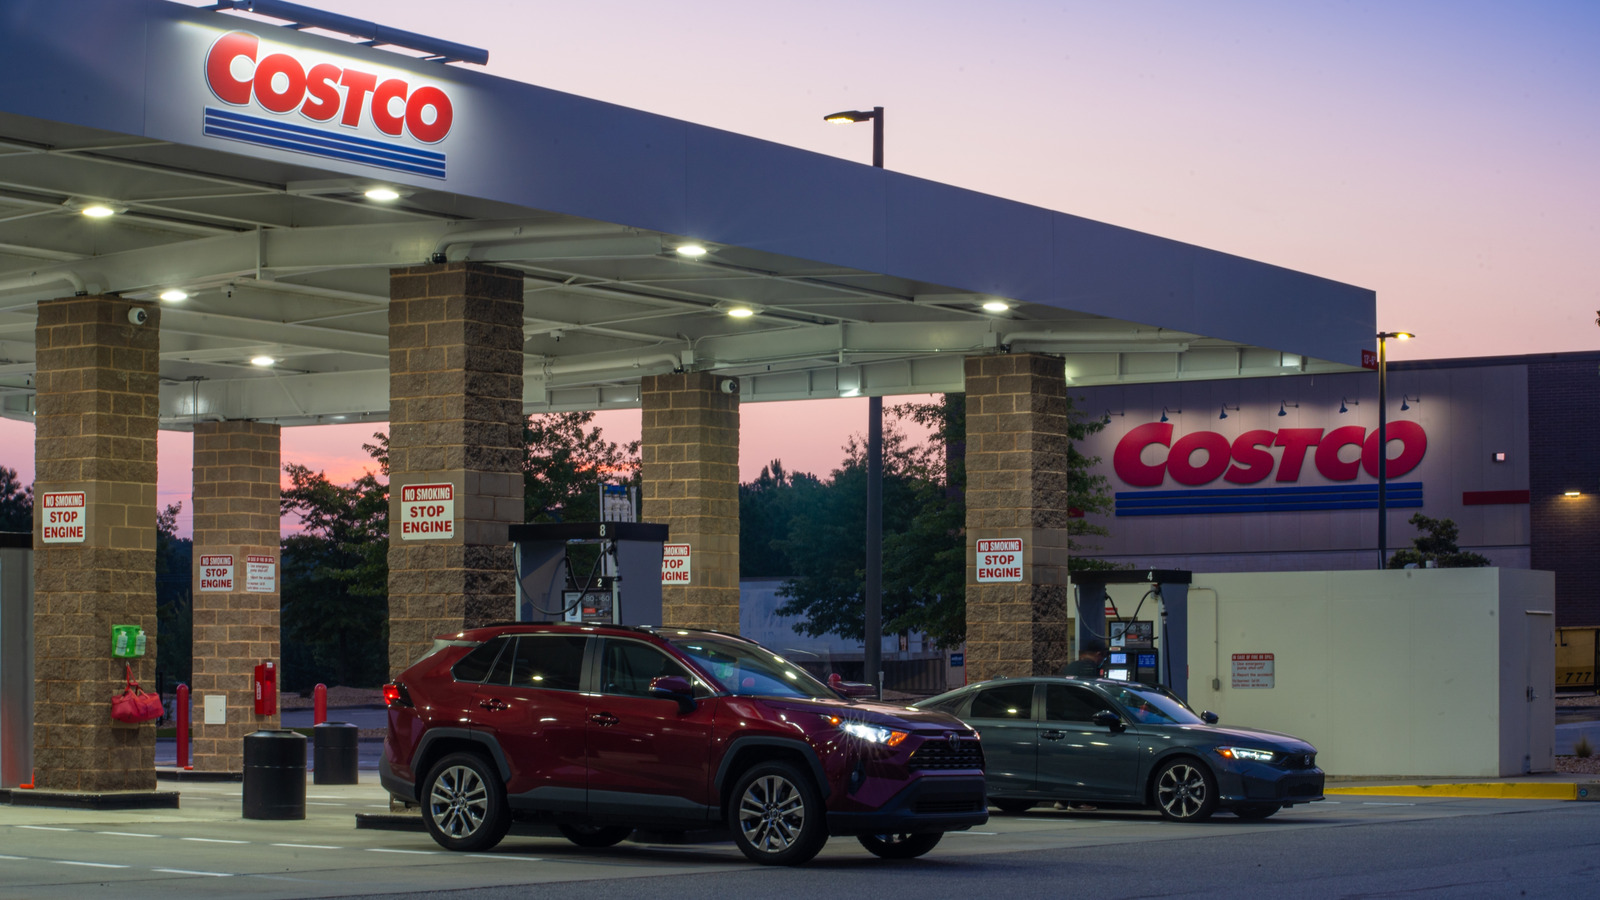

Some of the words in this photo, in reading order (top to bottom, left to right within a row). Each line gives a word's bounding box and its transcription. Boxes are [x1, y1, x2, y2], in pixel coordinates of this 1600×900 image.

[205, 30, 454, 143] COSTCO
[1113, 420, 1428, 487] COSTCO
[405, 489, 415, 500] NO
[416, 487, 450, 500] SMOKING
[46, 496, 54, 507] NO
[55, 495, 82, 506] SMOKING
[50, 511, 78, 523] STOP
[410, 505, 445, 518] STOP
[44, 526, 84, 538] ENGINE
[403, 520, 452, 534] ENGINE
[600, 524, 606, 536] 8
[980, 542, 989, 551] NO
[990, 541, 1020, 551] SMOKING
[202, 557, 209, 565] NO
[210, 557, 232, 565] SMOKING
[662, 560, 684, 568] TOP
[985, 554, 1015, 566] STOP
[206, 568, 228, 577] STOP
[978, 568, 1021, 578] ENGINE
[1147, 572, 1153, 581] 4
[201, 580, 232, 588] ENGINE
[597, 578, 602, 588] 2
